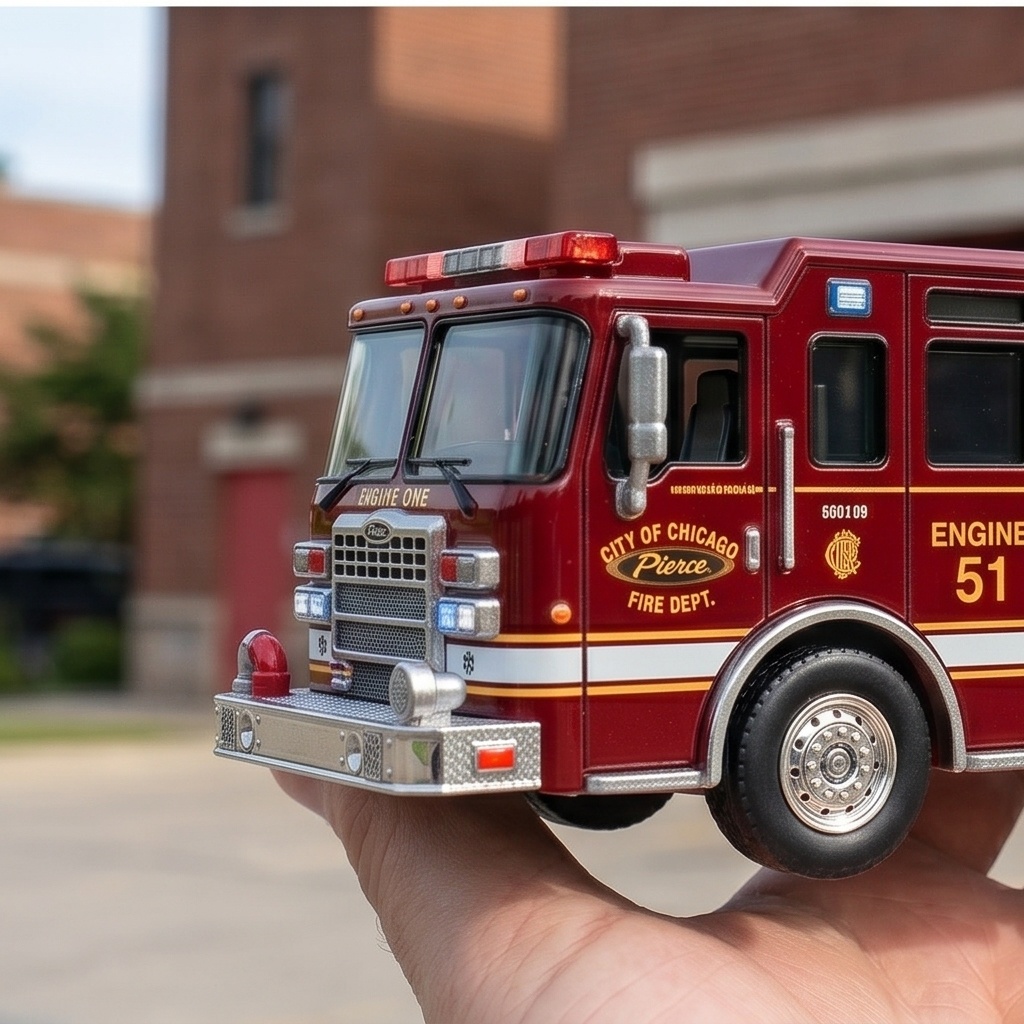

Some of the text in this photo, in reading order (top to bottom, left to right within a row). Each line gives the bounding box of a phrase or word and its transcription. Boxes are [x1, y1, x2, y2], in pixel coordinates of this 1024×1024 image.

[402, 488, 431, 507] ONE
[600, 522, 739, 564] CITY OF CHICAGO
[632, 552, 708, 579] Pierce
[956, 556, 1005, 604] 51
[627, 589, 716, 614] FIRE DEPT.
